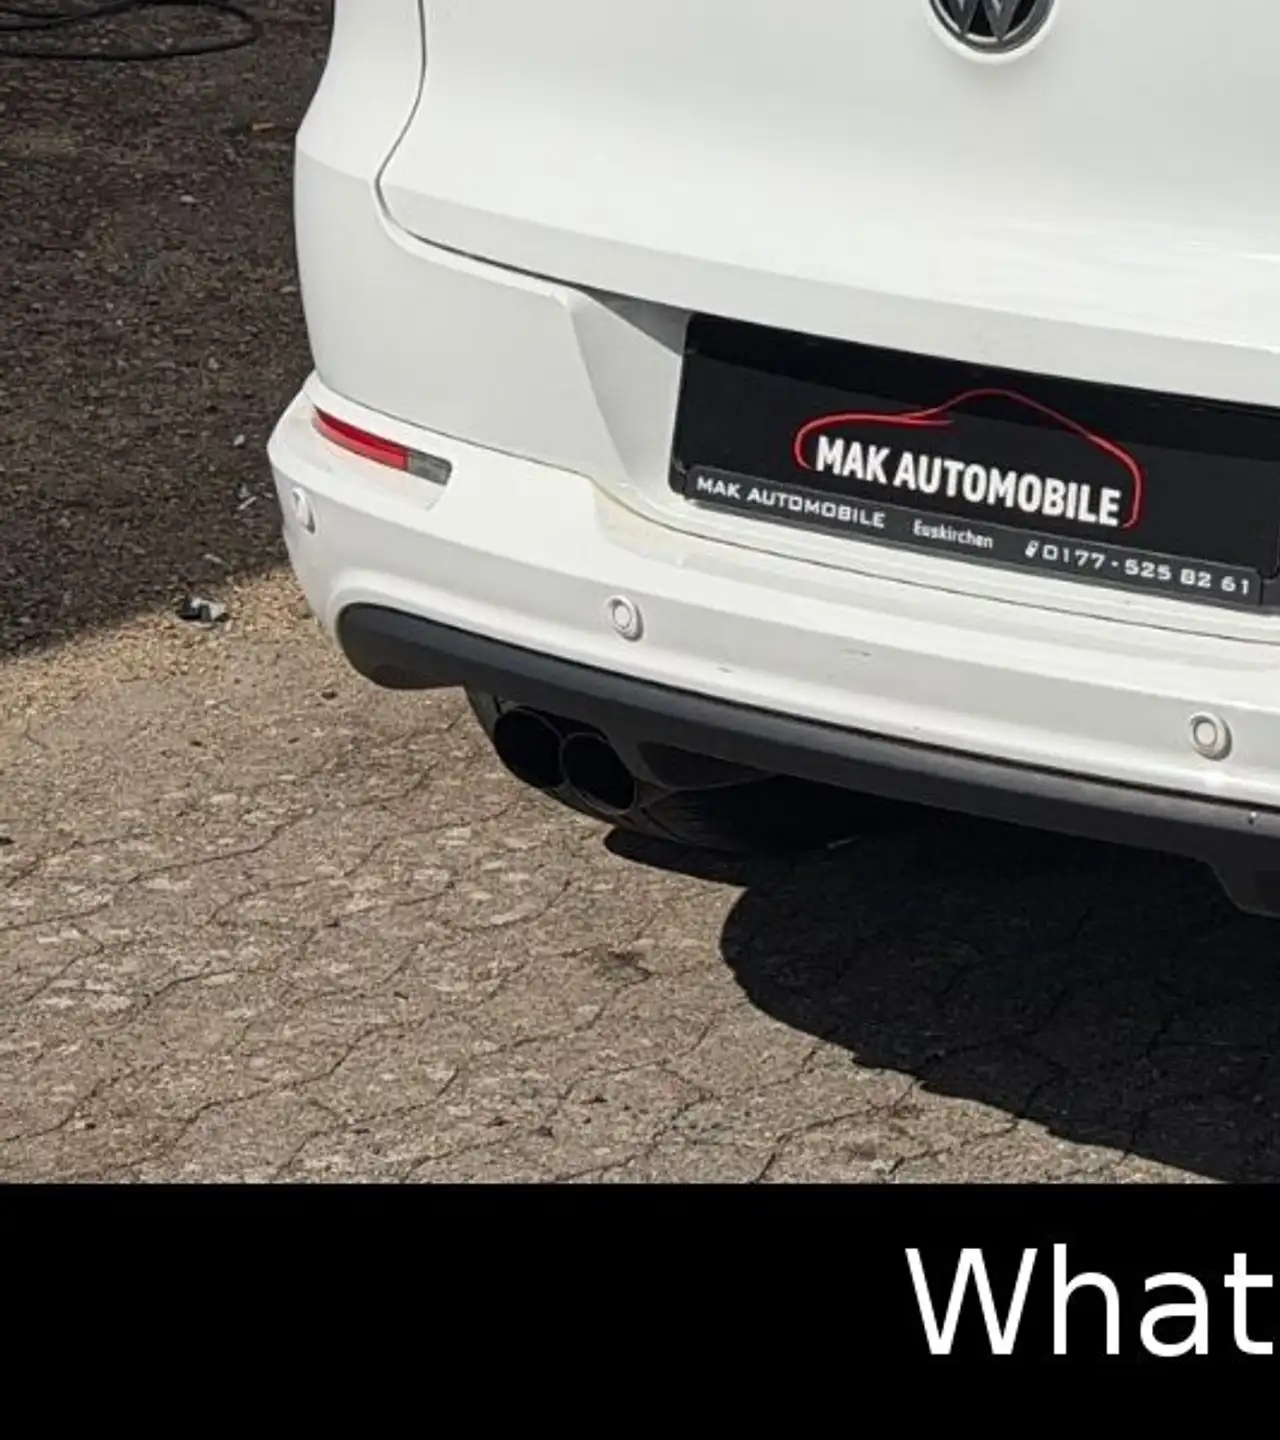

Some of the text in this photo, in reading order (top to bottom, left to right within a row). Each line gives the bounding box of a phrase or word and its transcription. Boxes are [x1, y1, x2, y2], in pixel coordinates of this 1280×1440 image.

[696, 475, 742, 500] MAK
[746, 486, 888, 529] AUTOMOBILE
[911, 517, 995, 550] Euskirchen
[814, 434, 1122, 528] MAK AUTOMOBILE
